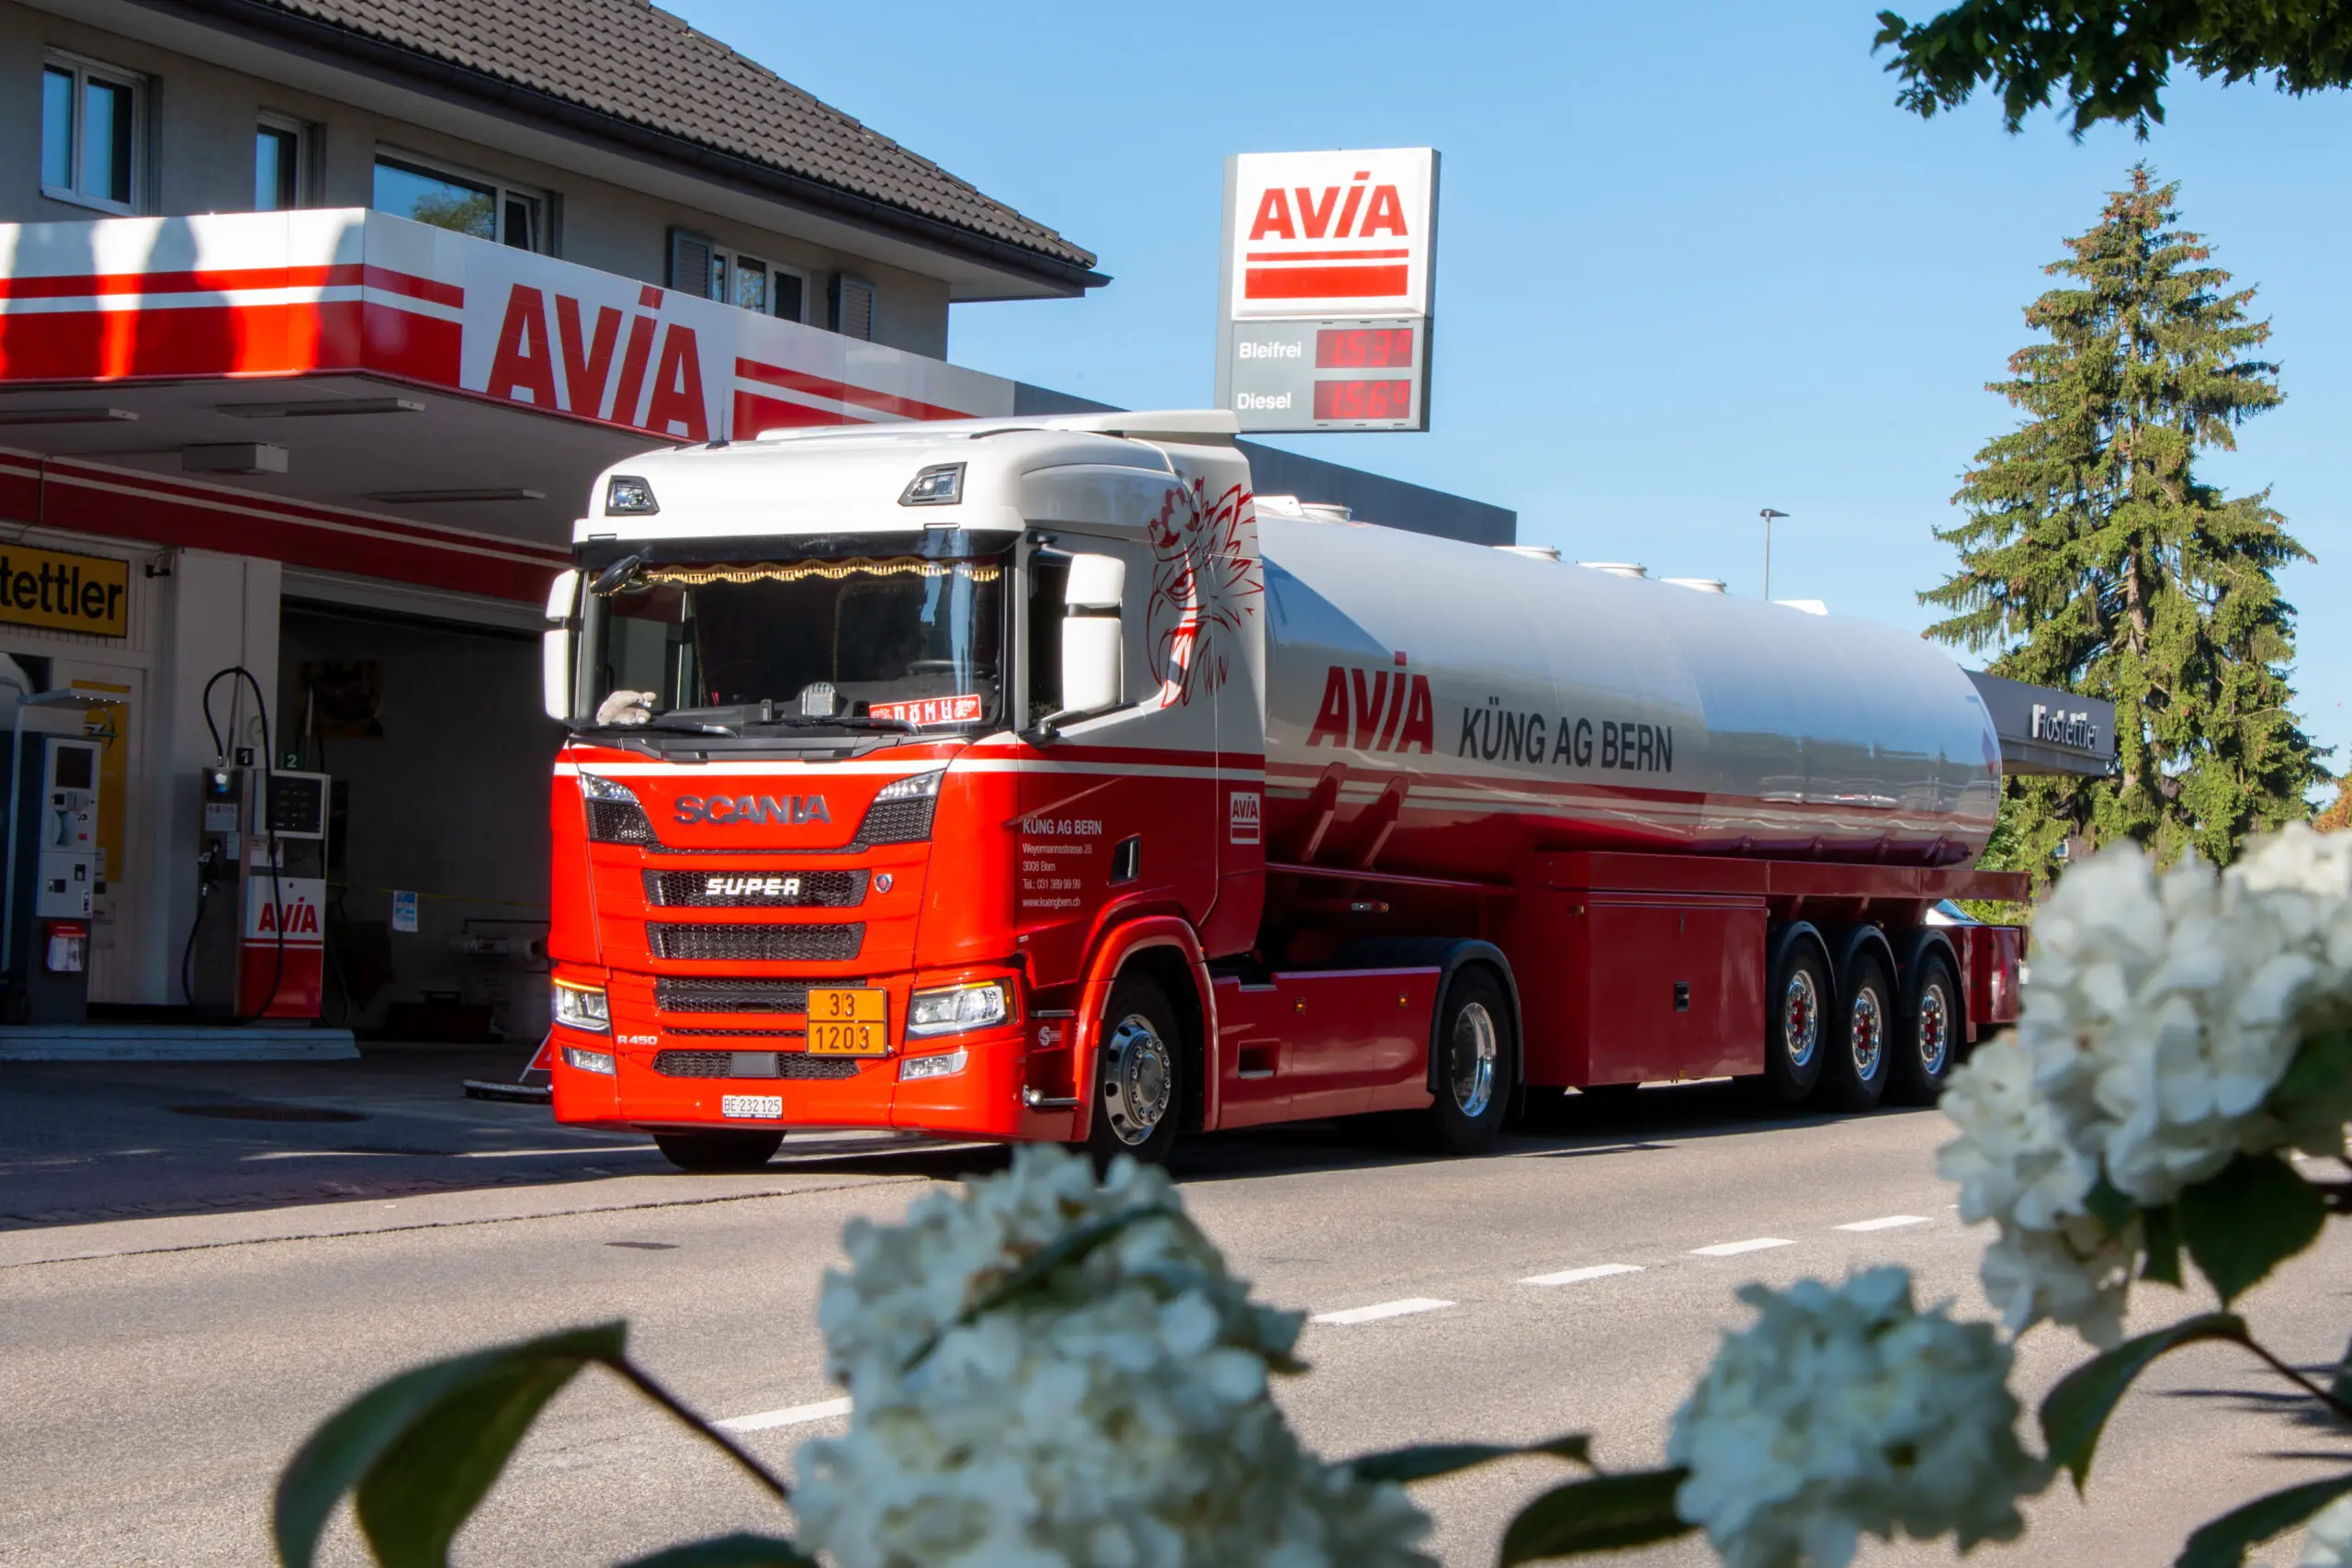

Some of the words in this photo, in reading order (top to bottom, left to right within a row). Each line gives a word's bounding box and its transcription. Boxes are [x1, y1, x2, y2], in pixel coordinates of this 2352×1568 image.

[1249, 171, 1408, 241] AVIA
[1239, 342, 1302, 359] Bleifrei
[486, 283, 710, 442] AVIA
[1237, 392, 1292, 410] Diesel
[1306, 650, 1433, 754] AVIA
[1458, 696, 1545, 763] KÜNG
[1552, 717, 1593, 768] AG
[1600, 721, 1673, 773] BERN
[241, 750, 249, 764] 1
[287, 754, 298, 768] 2
[673, 795, 832, 825] SCANIA
[1232, 795, 1258, 818] AVIA
[1023, 815, 1055, 834] KÜNG
[1057, 819, 1072, 835] AG
[1074, 819, 1102, 835] BERN
[1041, 862, 1056, 872] Bern
[706, 878, 800, 896] SUPER
[830, 993, 855, 1017] 33
[628, 1035, 658, 1045] 450
[816, 1025, 869, 1050] 1203
